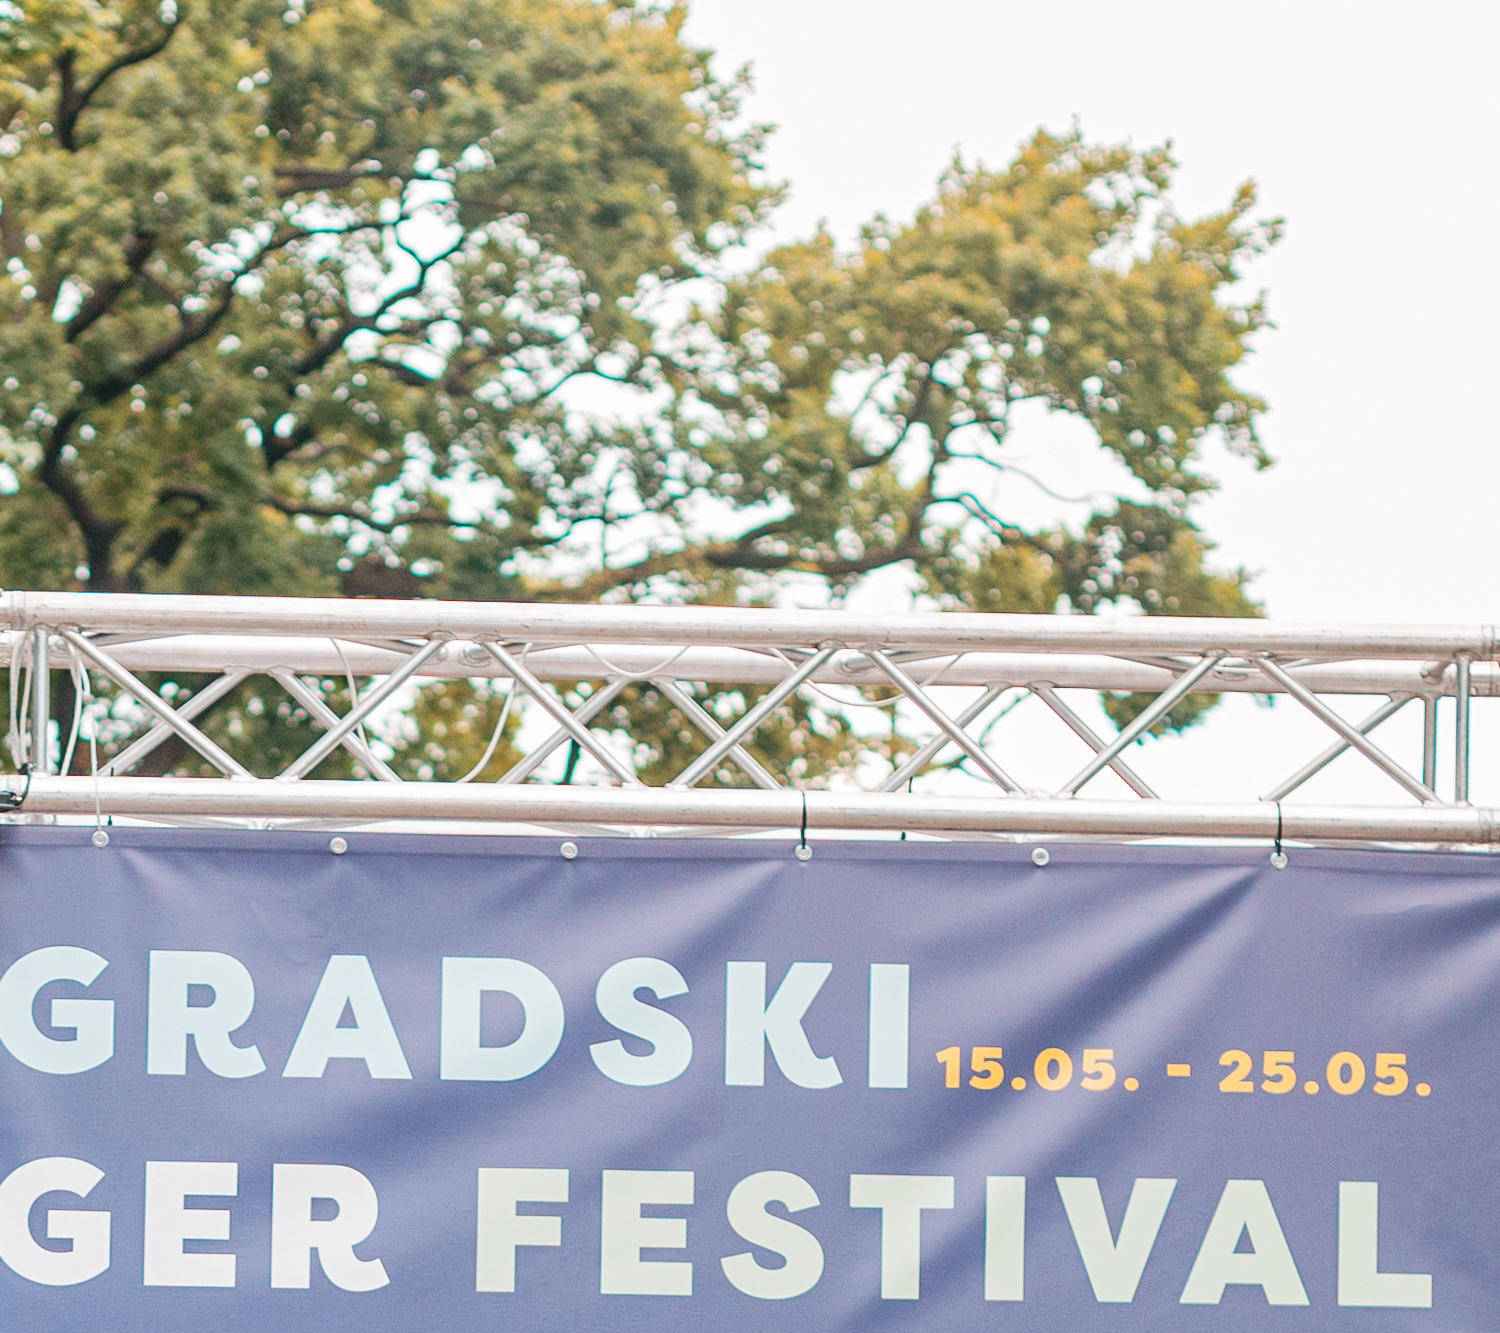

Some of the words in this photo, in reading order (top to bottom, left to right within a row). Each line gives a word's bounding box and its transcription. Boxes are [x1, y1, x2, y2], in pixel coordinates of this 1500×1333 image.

[934, 1045, 1141, 1094] 15.05.
[1218, 1050, 1433, 1098] 25.05.
[475, 1166, 1434, 1309] FESTIVAL
